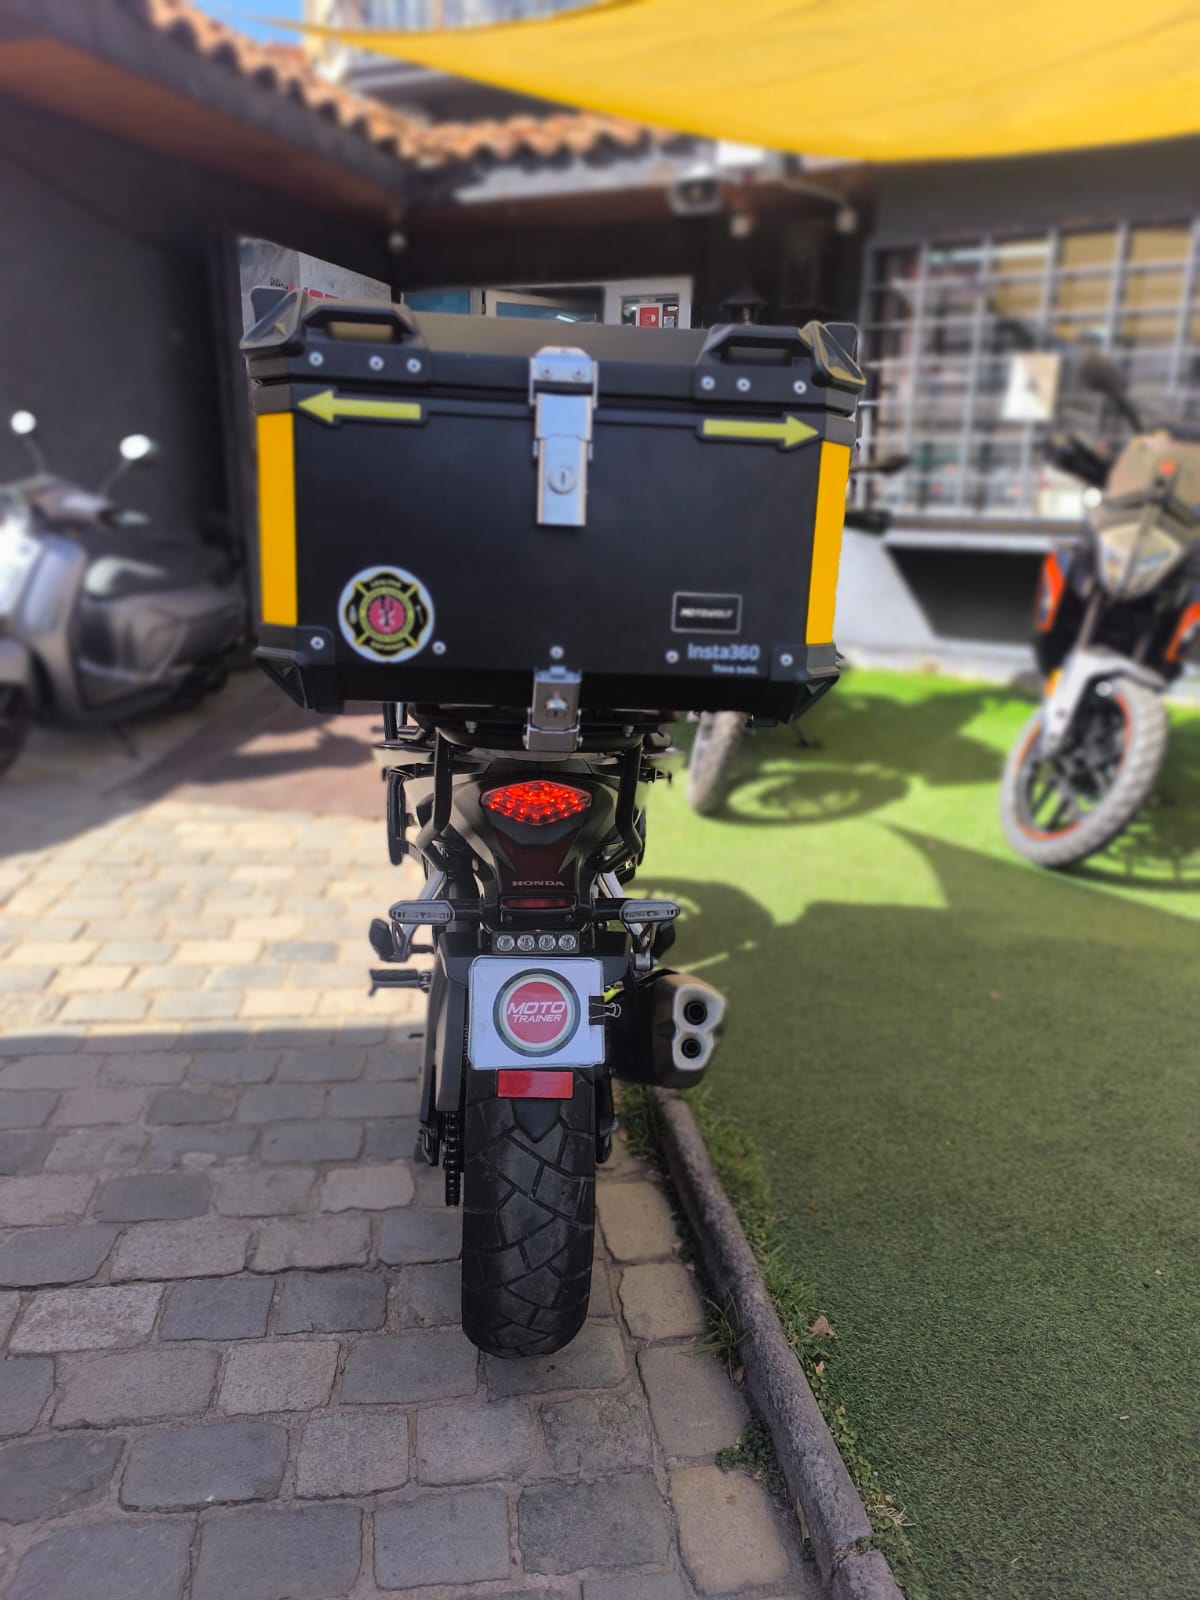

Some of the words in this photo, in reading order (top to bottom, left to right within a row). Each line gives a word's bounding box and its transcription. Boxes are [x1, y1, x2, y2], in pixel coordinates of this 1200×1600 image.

[687, 643, 760, 660] Insta360
[507, 1001, 567, 1016] MOTO
[513, 1014, 562, 1024] TRAINER
